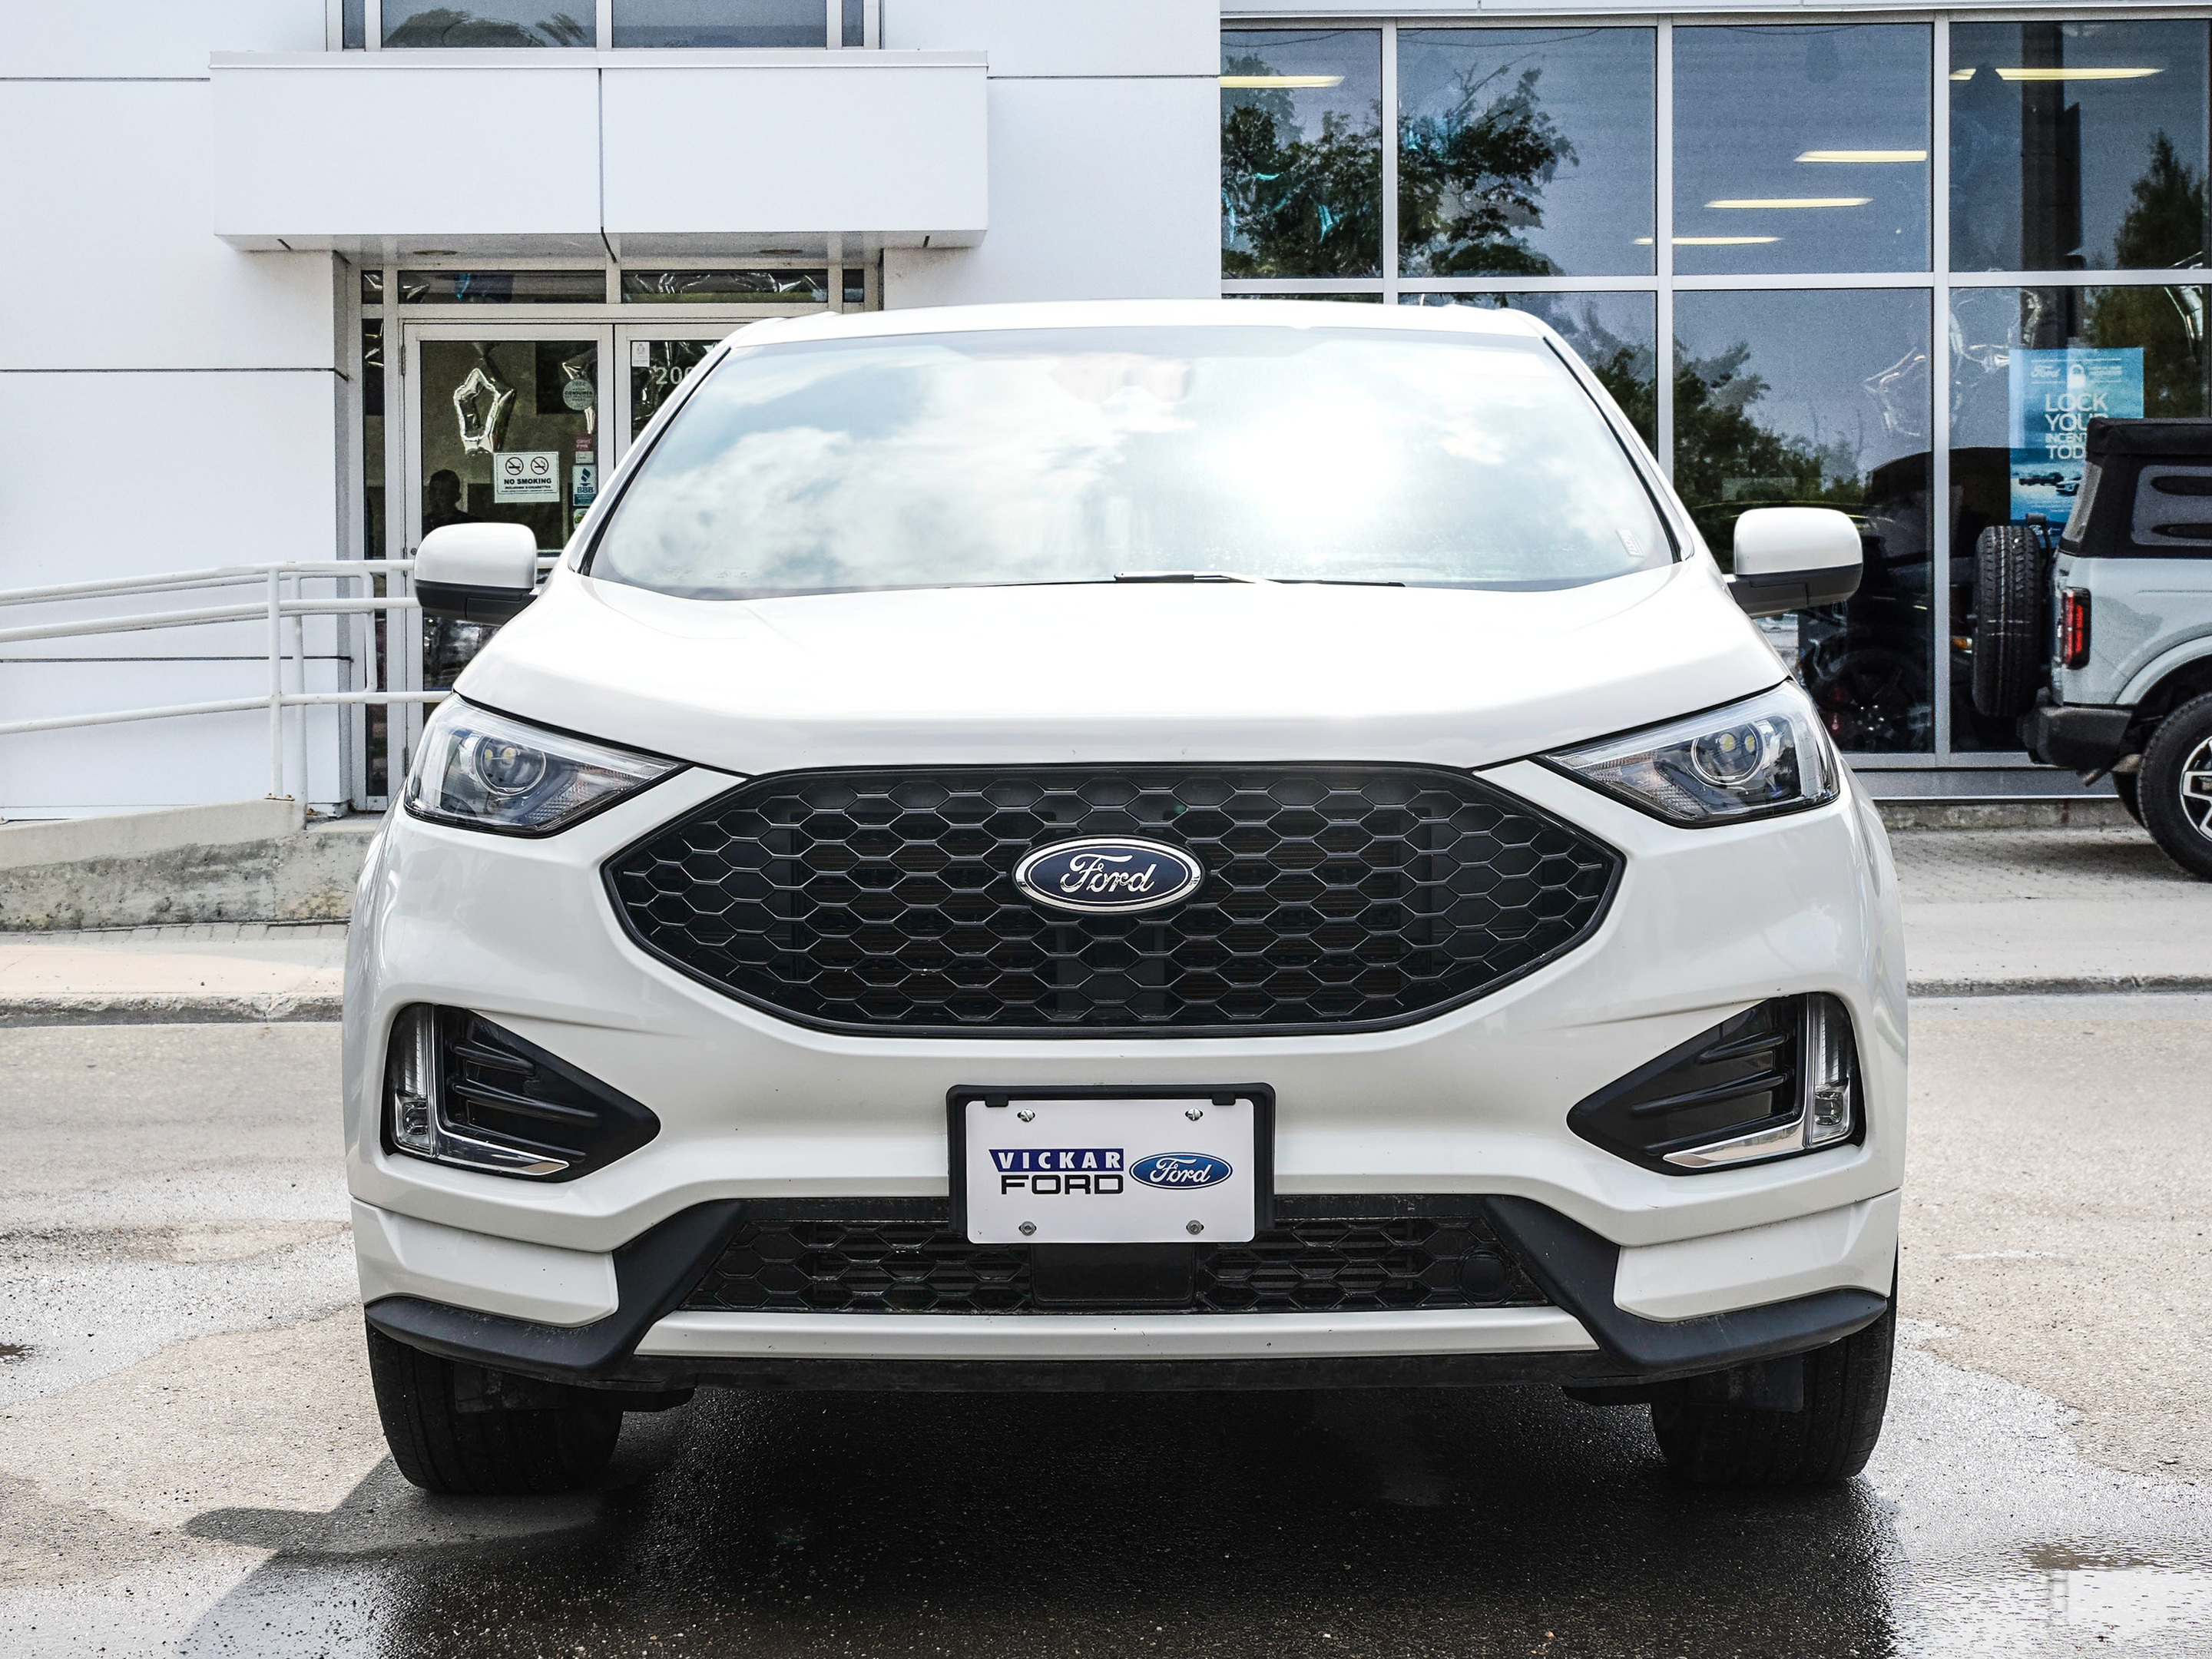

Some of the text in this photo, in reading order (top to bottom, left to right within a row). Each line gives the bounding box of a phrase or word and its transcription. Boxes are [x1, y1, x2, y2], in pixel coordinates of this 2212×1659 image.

[2045, 392, 2108, 412] LOCK
[2045, 412, 2108, 432] YOU
[1059, 853, 1157, 893] Ford
[998, 1151, 1121, 1169] VICKAR
[1149, 1157, 1212, 1183] Ford
[1001, 1174, 1124, 1195] FORD
